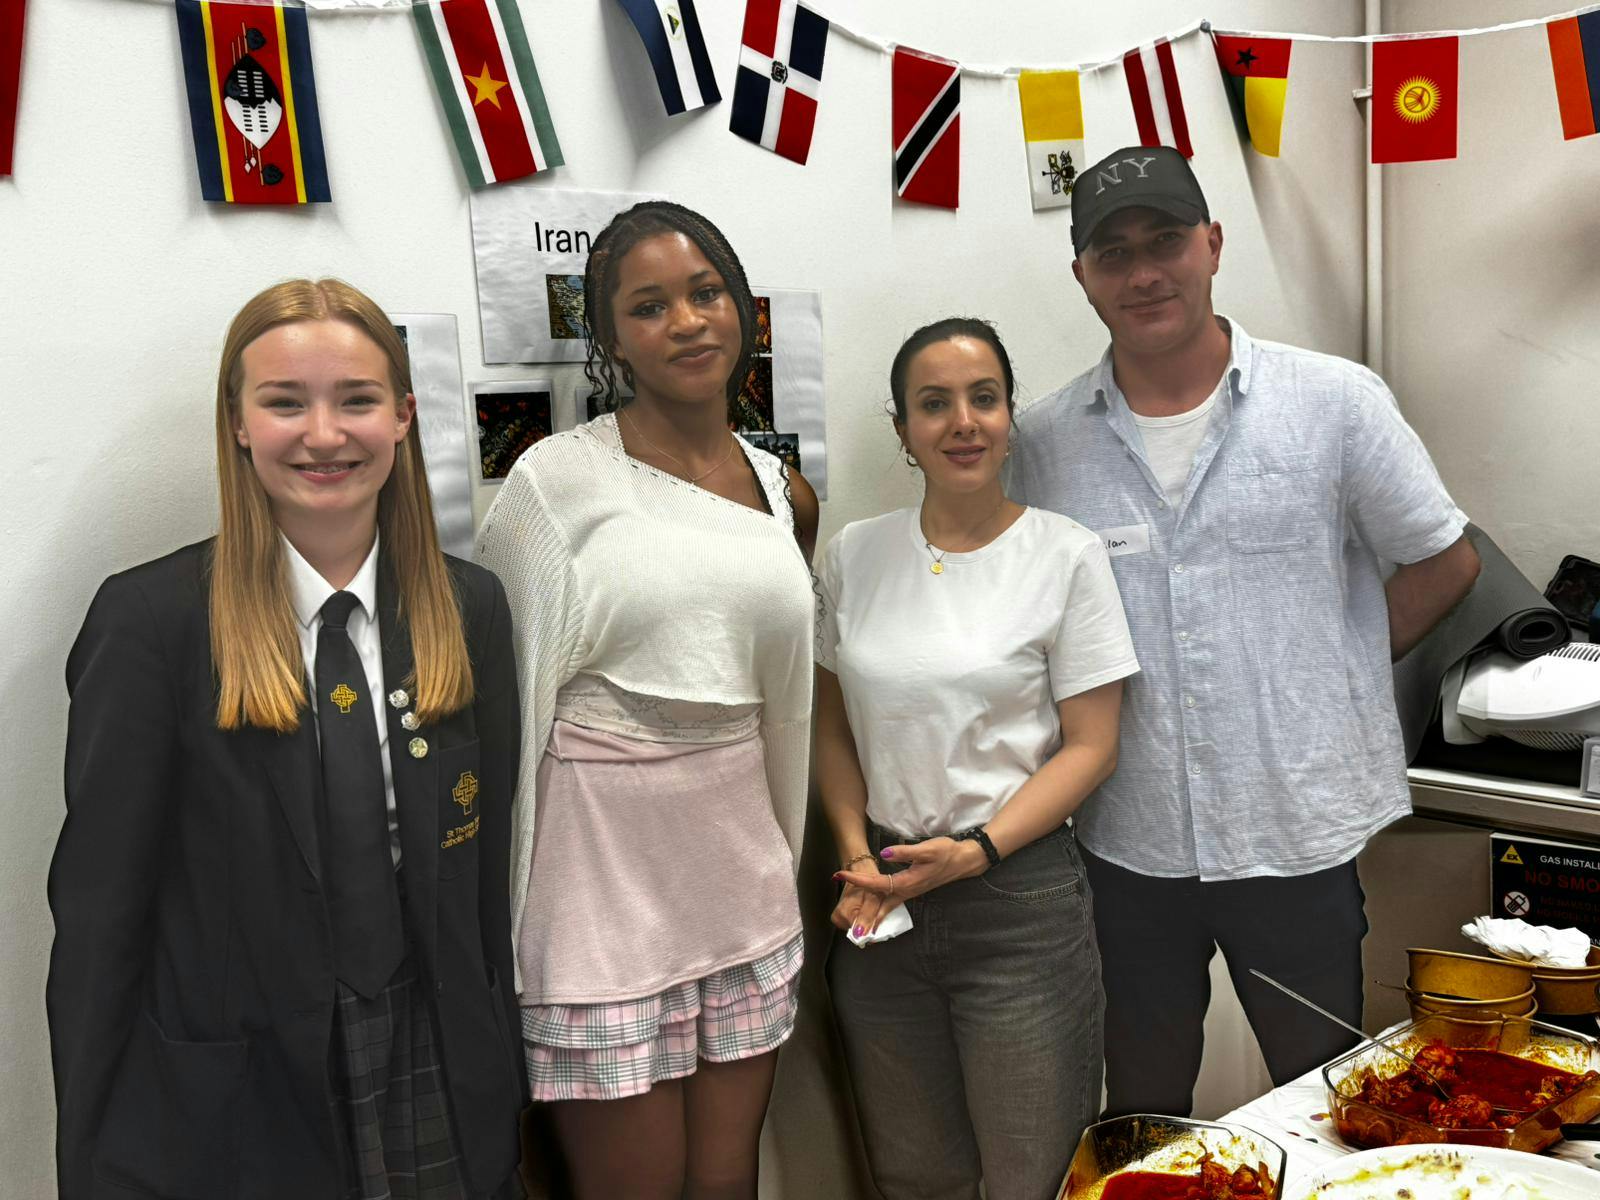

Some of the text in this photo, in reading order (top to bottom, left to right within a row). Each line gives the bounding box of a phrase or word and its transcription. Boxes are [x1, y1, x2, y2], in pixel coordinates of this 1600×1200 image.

[1096, 157, 1156, 195] NY
[535, 221, 591, 253] Iran
[1507, 853, 1519, 861] EX
[1540, 855, 1561, 865] GAS
[1525, 868, 1552, 886] NO
